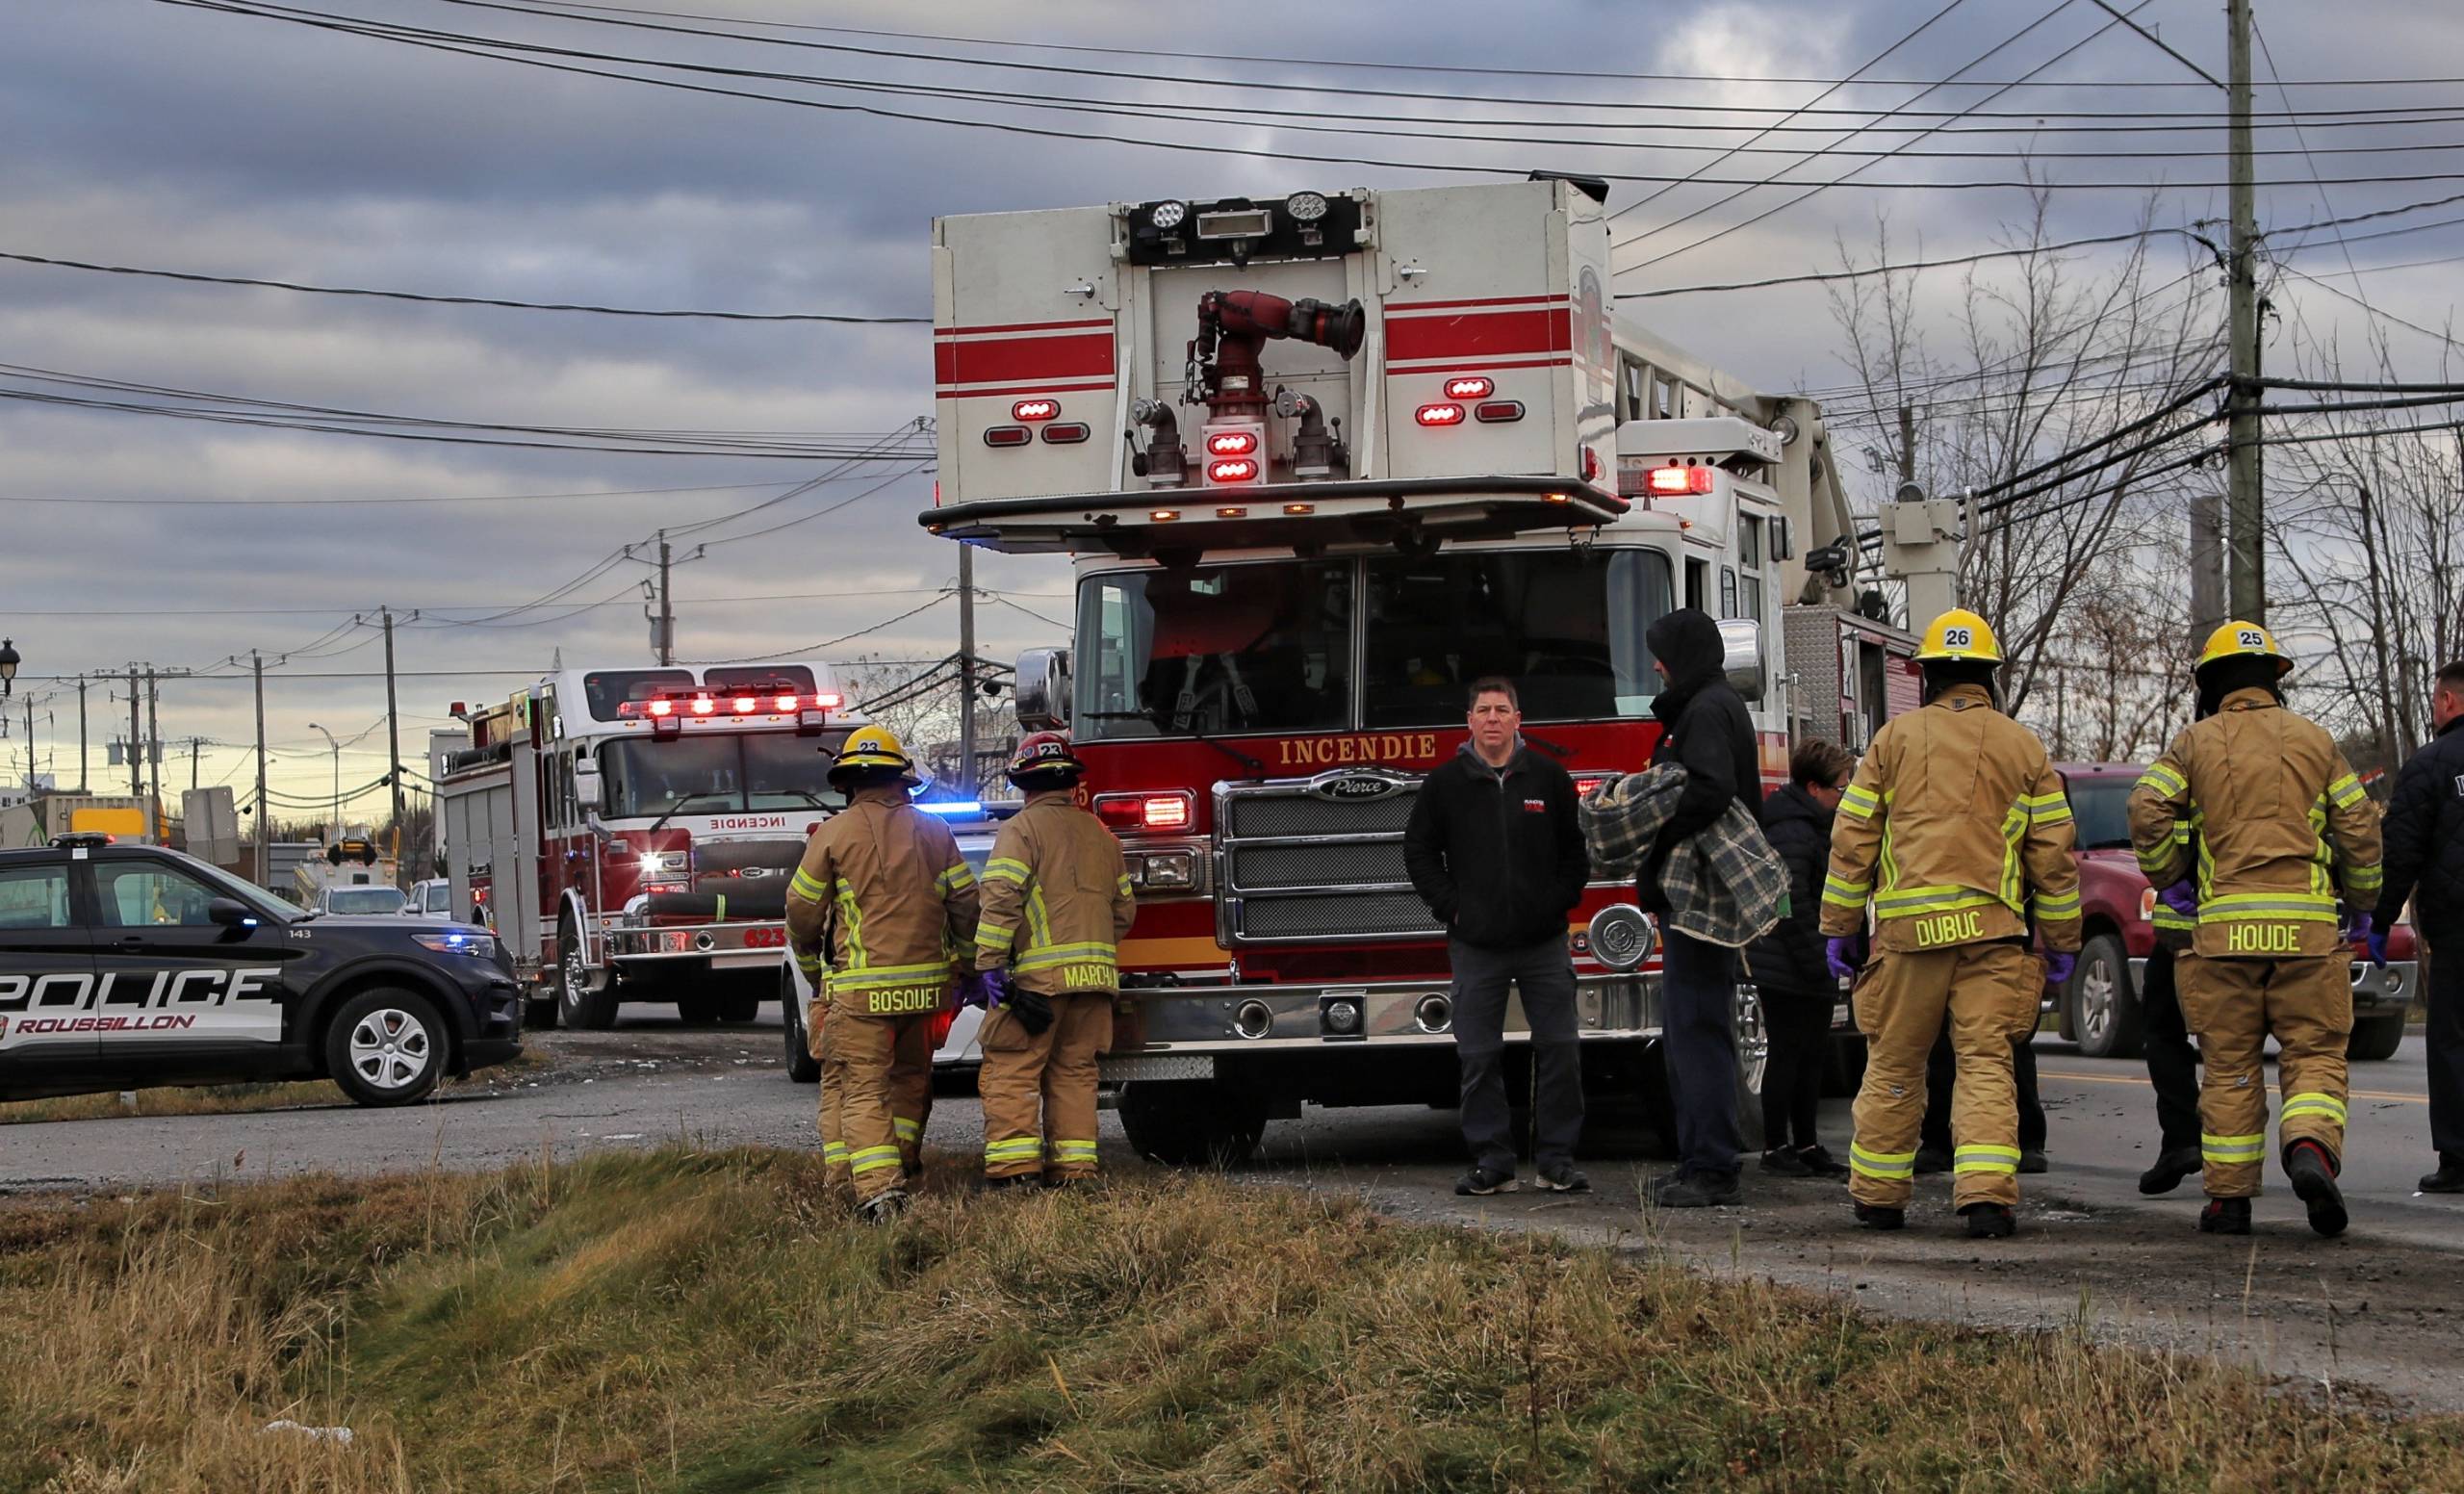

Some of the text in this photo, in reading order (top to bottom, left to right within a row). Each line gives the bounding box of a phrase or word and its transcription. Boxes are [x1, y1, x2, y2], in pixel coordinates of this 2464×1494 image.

[1945, 629, 1969, 646] 26
[2240, 631, 2263, 646] 25
[860, 740, 878, 753] 23
[1040, 744, 1061, 757] 23
[1279, 734, 1436, 764] INCENDIE
[1332, 778, 1382, 797] Pierce
[288, 929, 312, 940] 143
[744, 927, 786, 948] 623
[1915, 911, 1985, 947] DUBUC
[2228, 924, 2301, 953] HOUDE
[868, 987, 941, 1013] BOSQUET
[15, 1015, 196, 1035] ROUSSILLON
